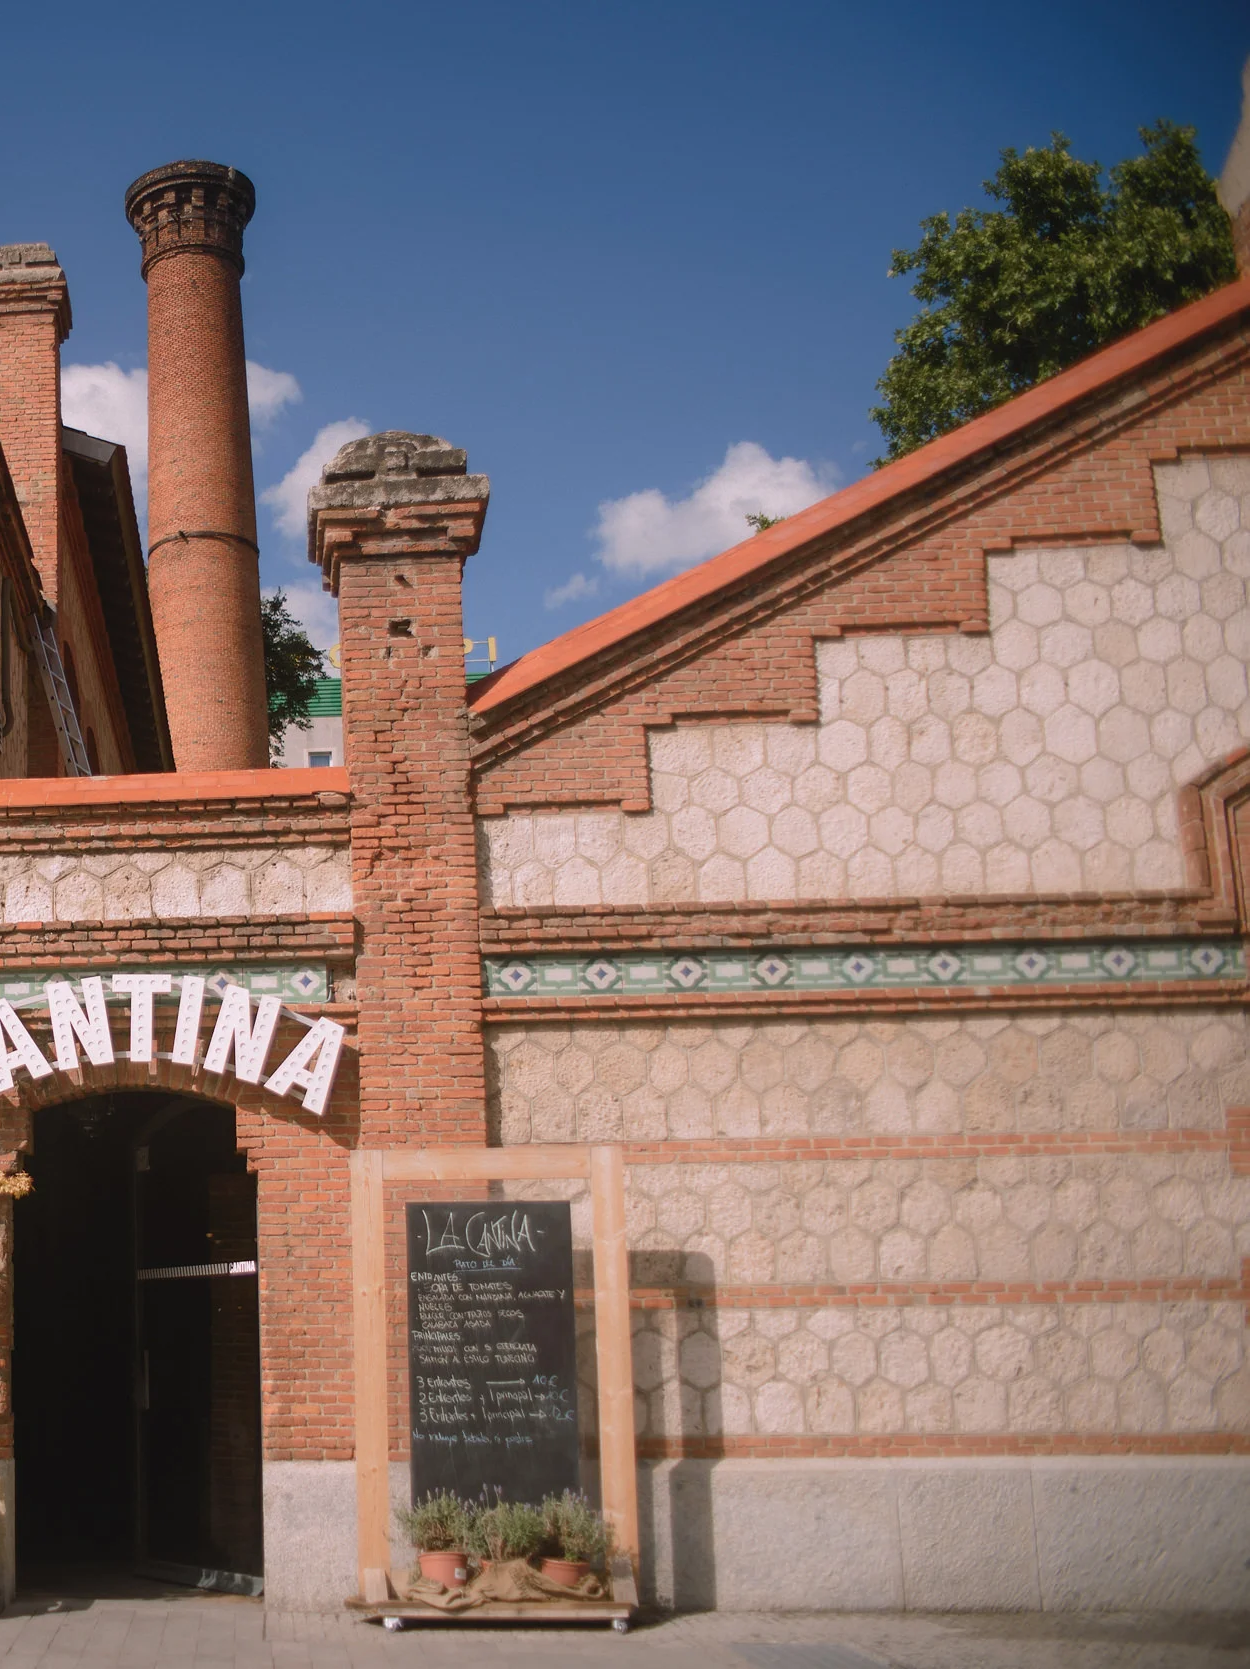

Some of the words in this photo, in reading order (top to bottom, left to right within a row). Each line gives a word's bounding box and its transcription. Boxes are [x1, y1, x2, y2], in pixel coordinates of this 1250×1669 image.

[422, 1210, 465, 1255] LA
[466, 1209, 536, 1257] CANTINA
[229, 1261, 255, 1274] CANTINA
[452, 1283, 463, 1292] DE
[468, 1282, 512, 1291] TOMATES
[557, 1289, 565, 1299] Y
[449, 1312, 463, 1320] CON
[498, 1309, 524, 1318] SECOS
[464, 1320, 491, 1328] ASADA
[464, 1354, 490, 1364] ESTILO
[416, 1376, 425, 1388] 3
[427, 1374, 471, 1389] Entrantes
[419, 1392, 428, 1405] 2
[429, 1389, 472, 1403] Entrantes
[496, 1387, 533, 1408] principal
[419, 1407, 428, 1422] 3
[429, 1406, 468, 1423] Entrantes
[487, 1408, 525, 1423] principal
[412, 1428, 424, 1439] No
